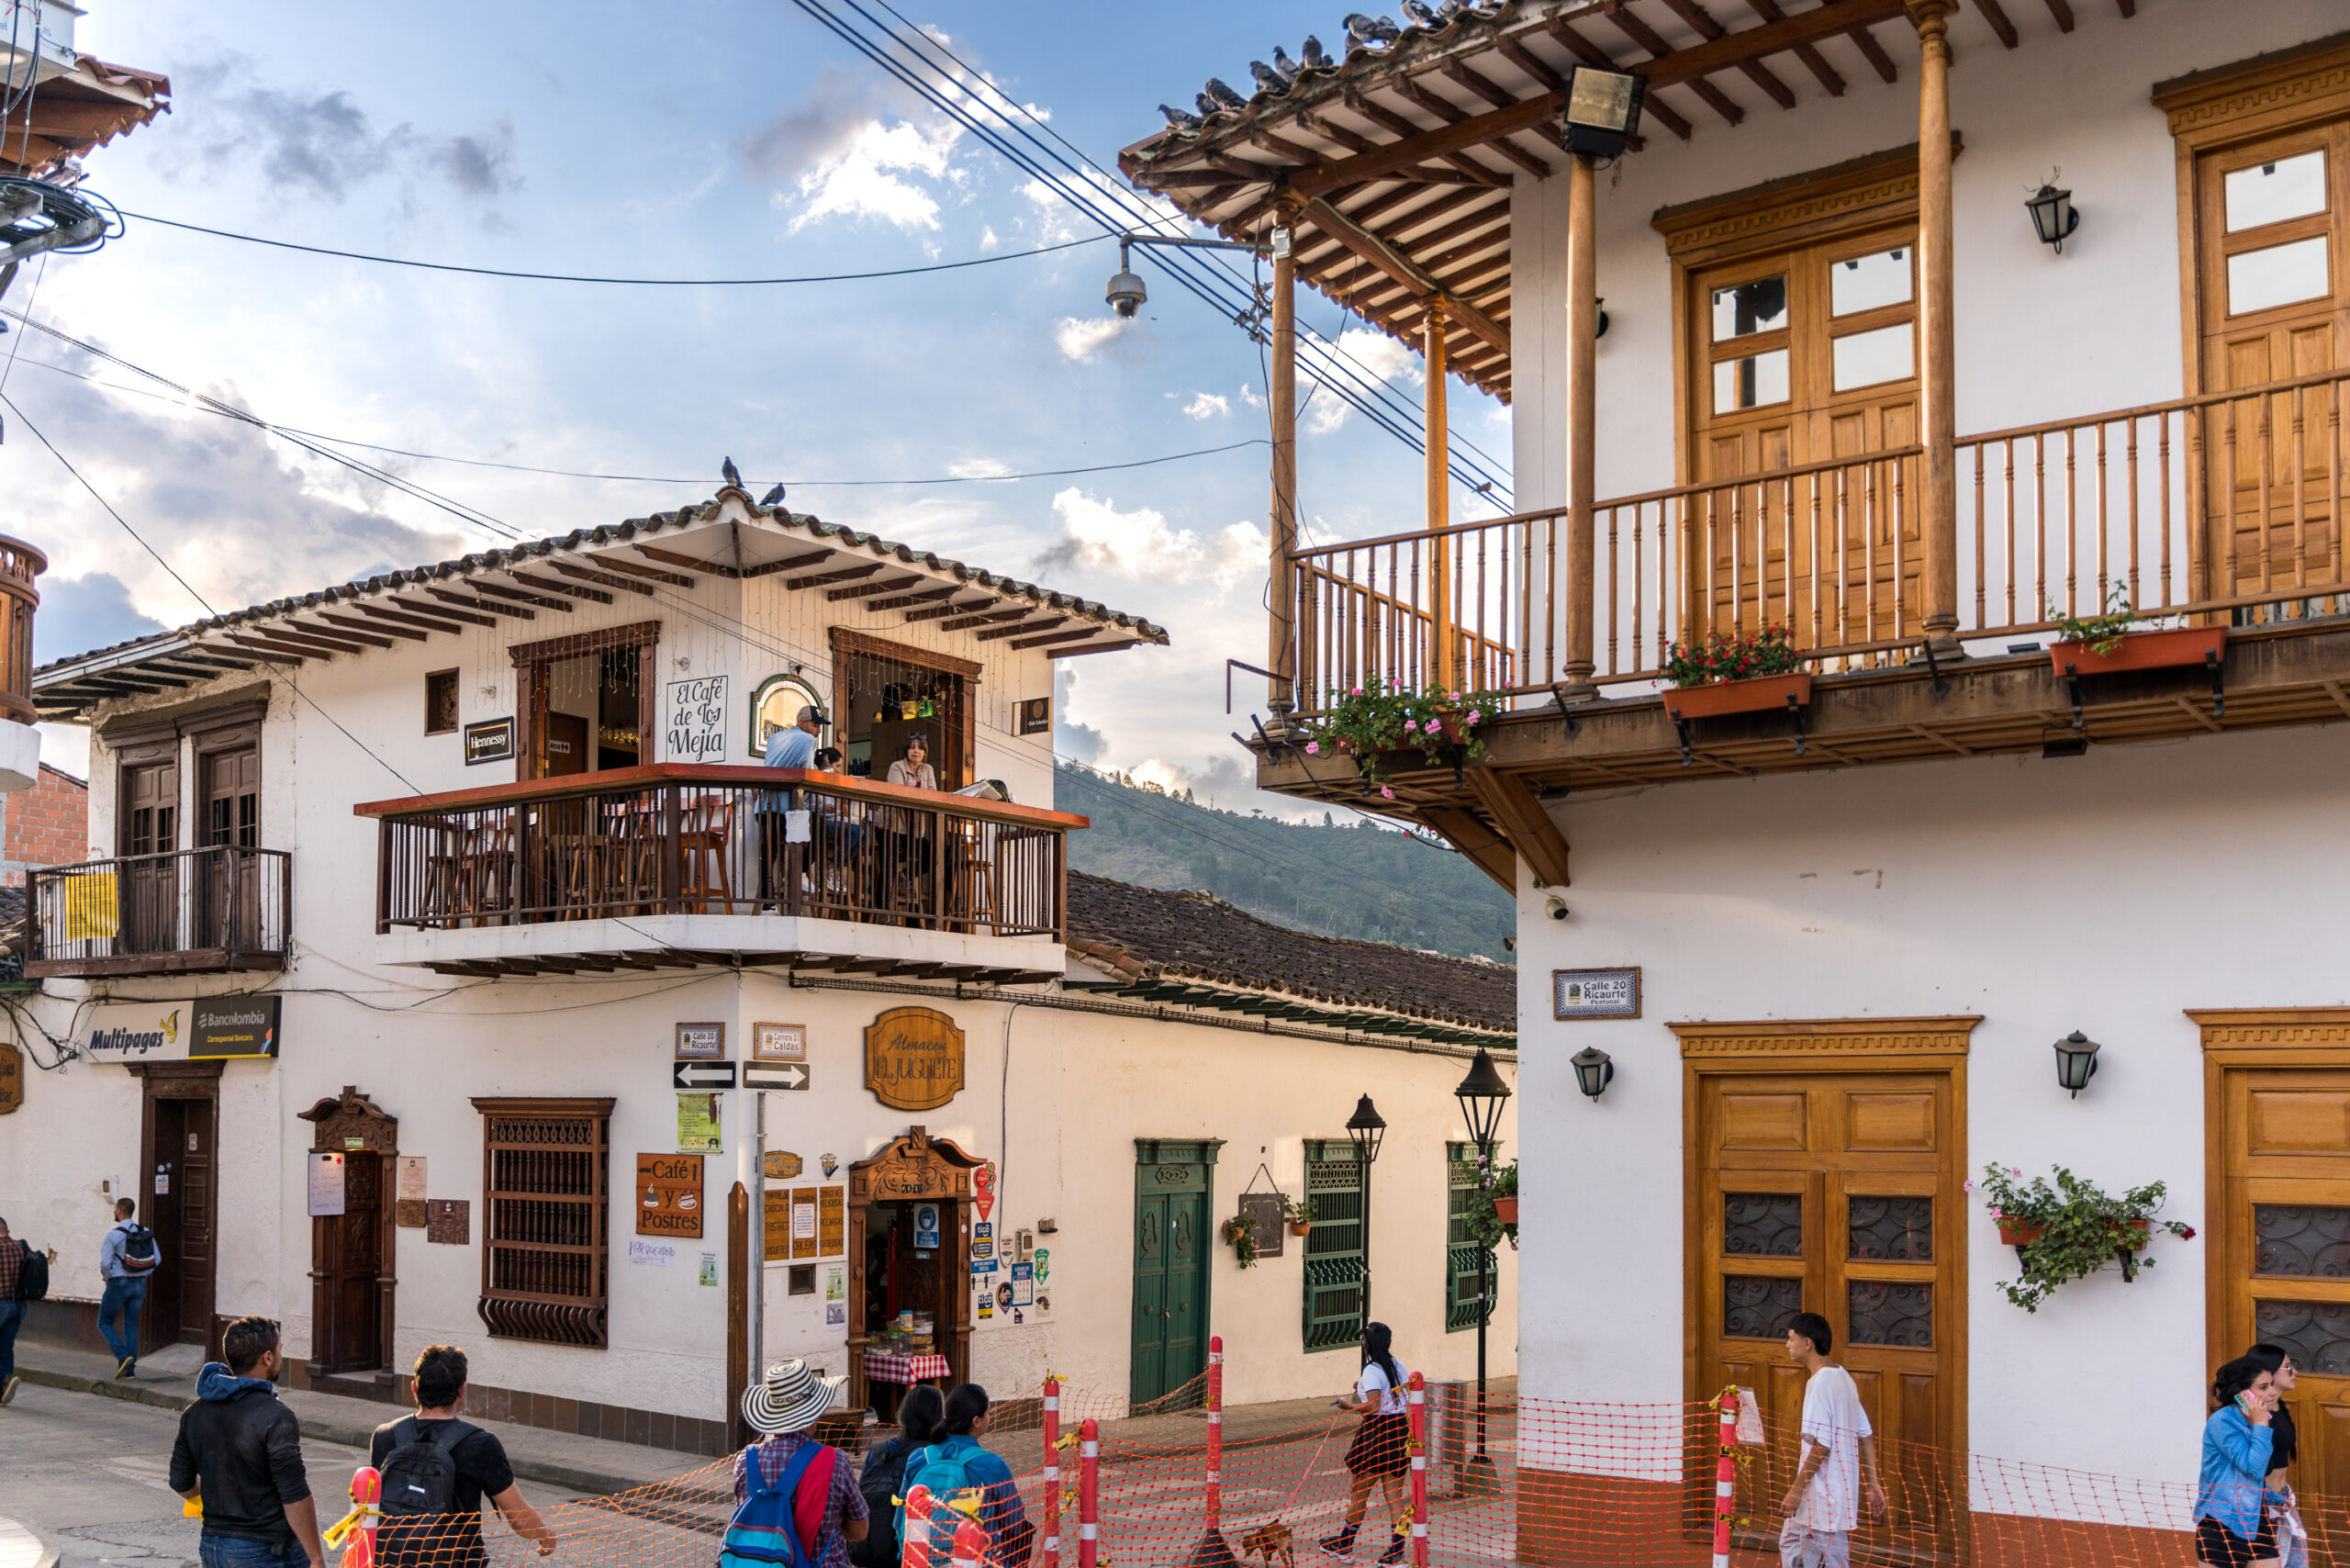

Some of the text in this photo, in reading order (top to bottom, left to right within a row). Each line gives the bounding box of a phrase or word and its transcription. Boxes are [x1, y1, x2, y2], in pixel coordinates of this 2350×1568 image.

[677, 678, 722, 706] El Café
[674, 702, 722, 726] de Los
[470, 734, 507, 749] Hennessy
[668, 726, 723, 762] Mejía
[1583, 980, 1627, 991] Calle 20
[1584, 990, 1627, 999] Ricaurte
[207, 1009, 265, 1026] Bancolombia
[89, 1027, 164, 1055] Multipagas
[691, 1040, 716, 1049] Ricaurte
[693, 1032, 715, 1040] Calle 20
[774, 1033, 793, 1042] Carrera
[888, 1034, 947, 1052] Almacen
[774, 1041, 800, 1051] Caldas
[876, 1058, 957, 1087] EL JUGUETE
[652, 1159, 688, 1180] Café
[665, 1191, 675, 1208] y
[641, 1210, 698, 1231] Postres
[792, 1240, 816, 1249] OBLEAS
